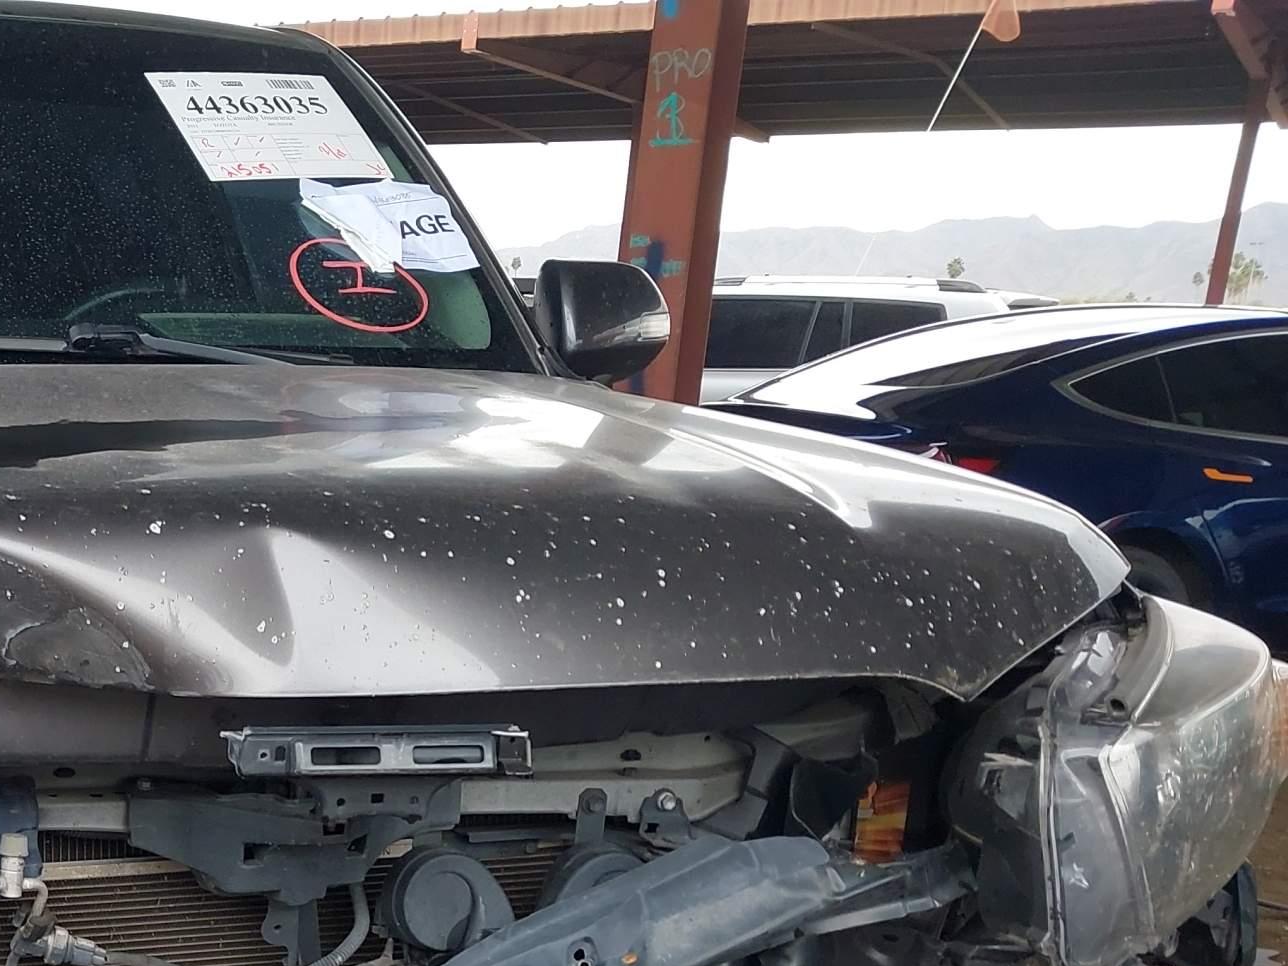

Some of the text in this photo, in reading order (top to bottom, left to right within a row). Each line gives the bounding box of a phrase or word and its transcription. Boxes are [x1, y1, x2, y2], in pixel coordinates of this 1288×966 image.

[652, 48, 712, 92] PRO
[186, 95, 328, 115] 44363035
[227, 114, 259, 122] Casualty
